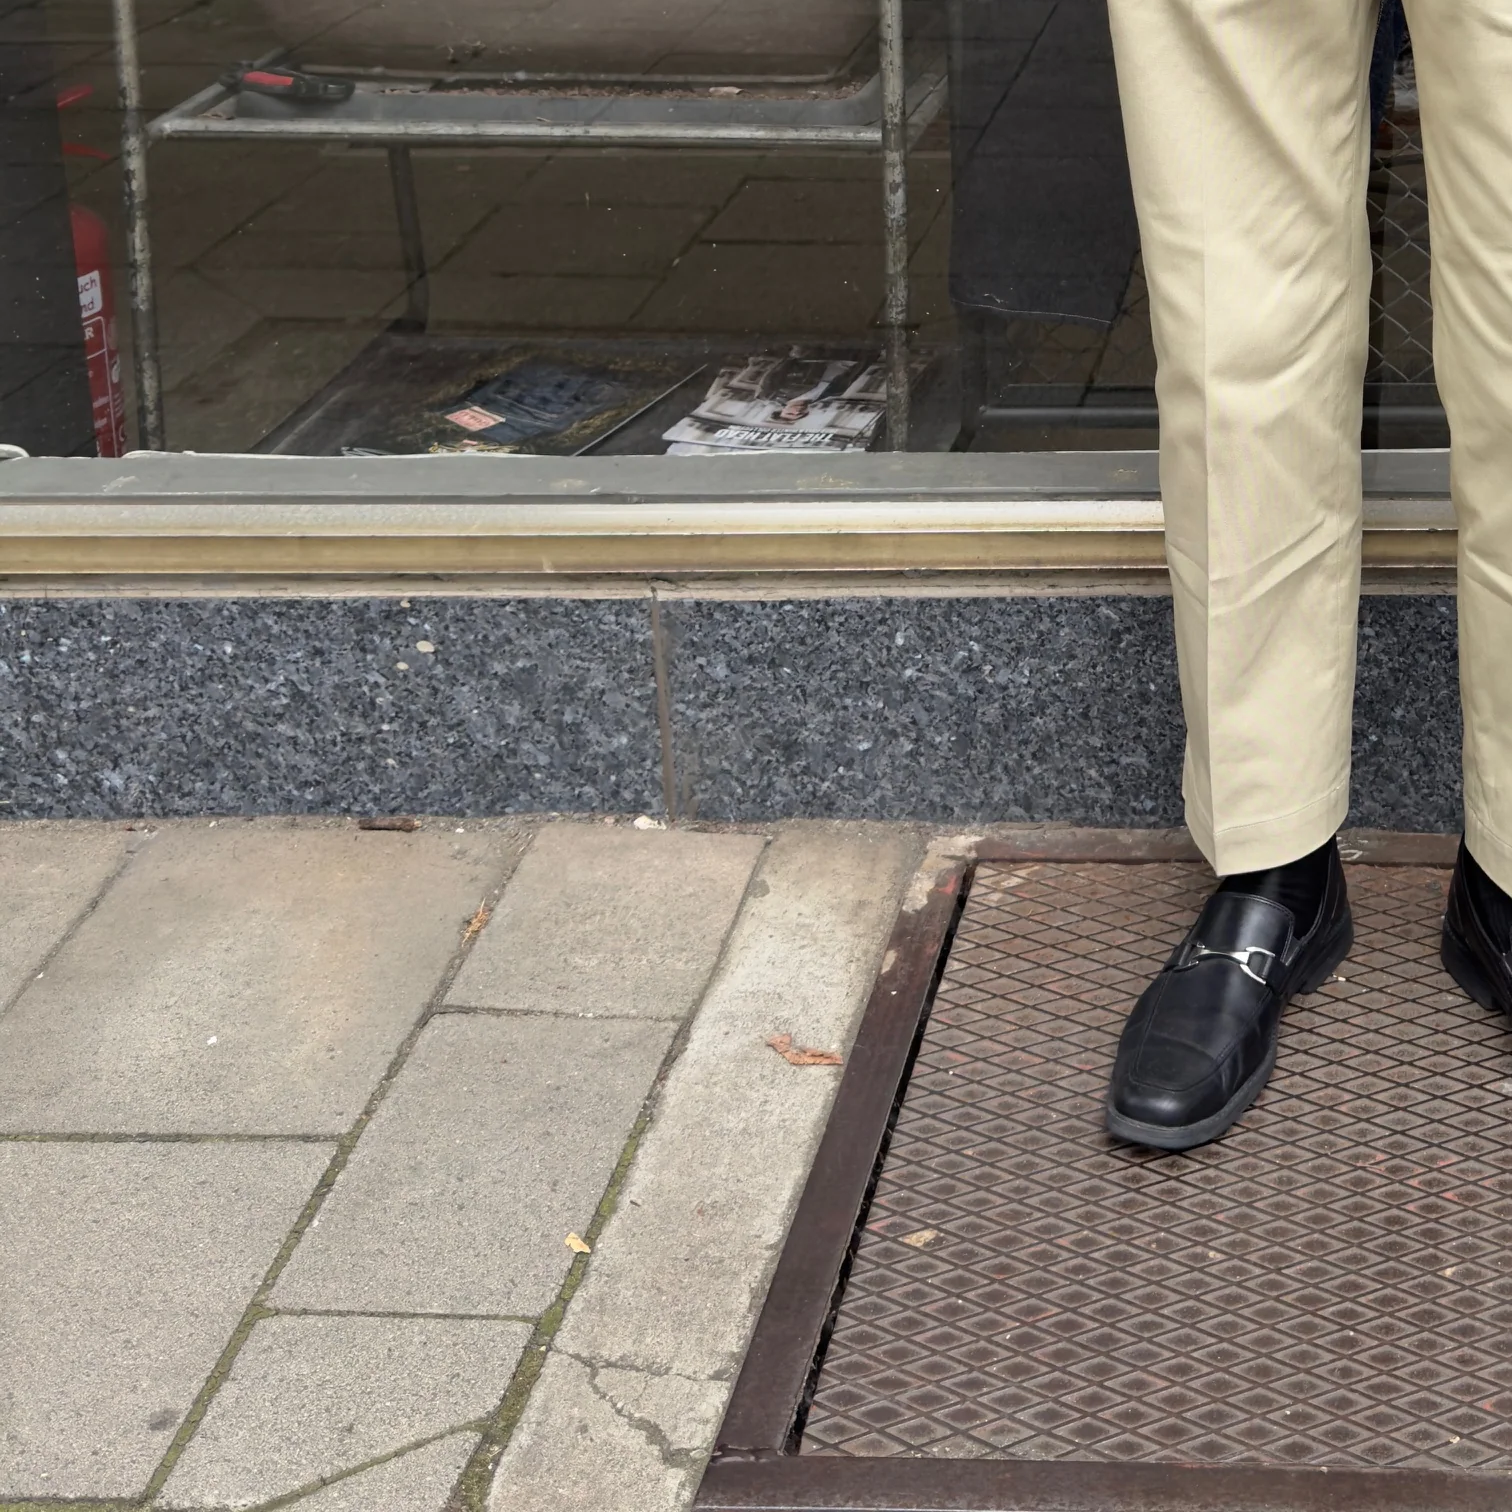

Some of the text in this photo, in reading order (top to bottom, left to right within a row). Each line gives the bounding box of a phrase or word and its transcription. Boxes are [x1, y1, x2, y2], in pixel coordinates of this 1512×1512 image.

[714, 428, 762, 440] HEAD
[761, 432, 801, 442] FLAT
[803, 433, 834, 442] THE
